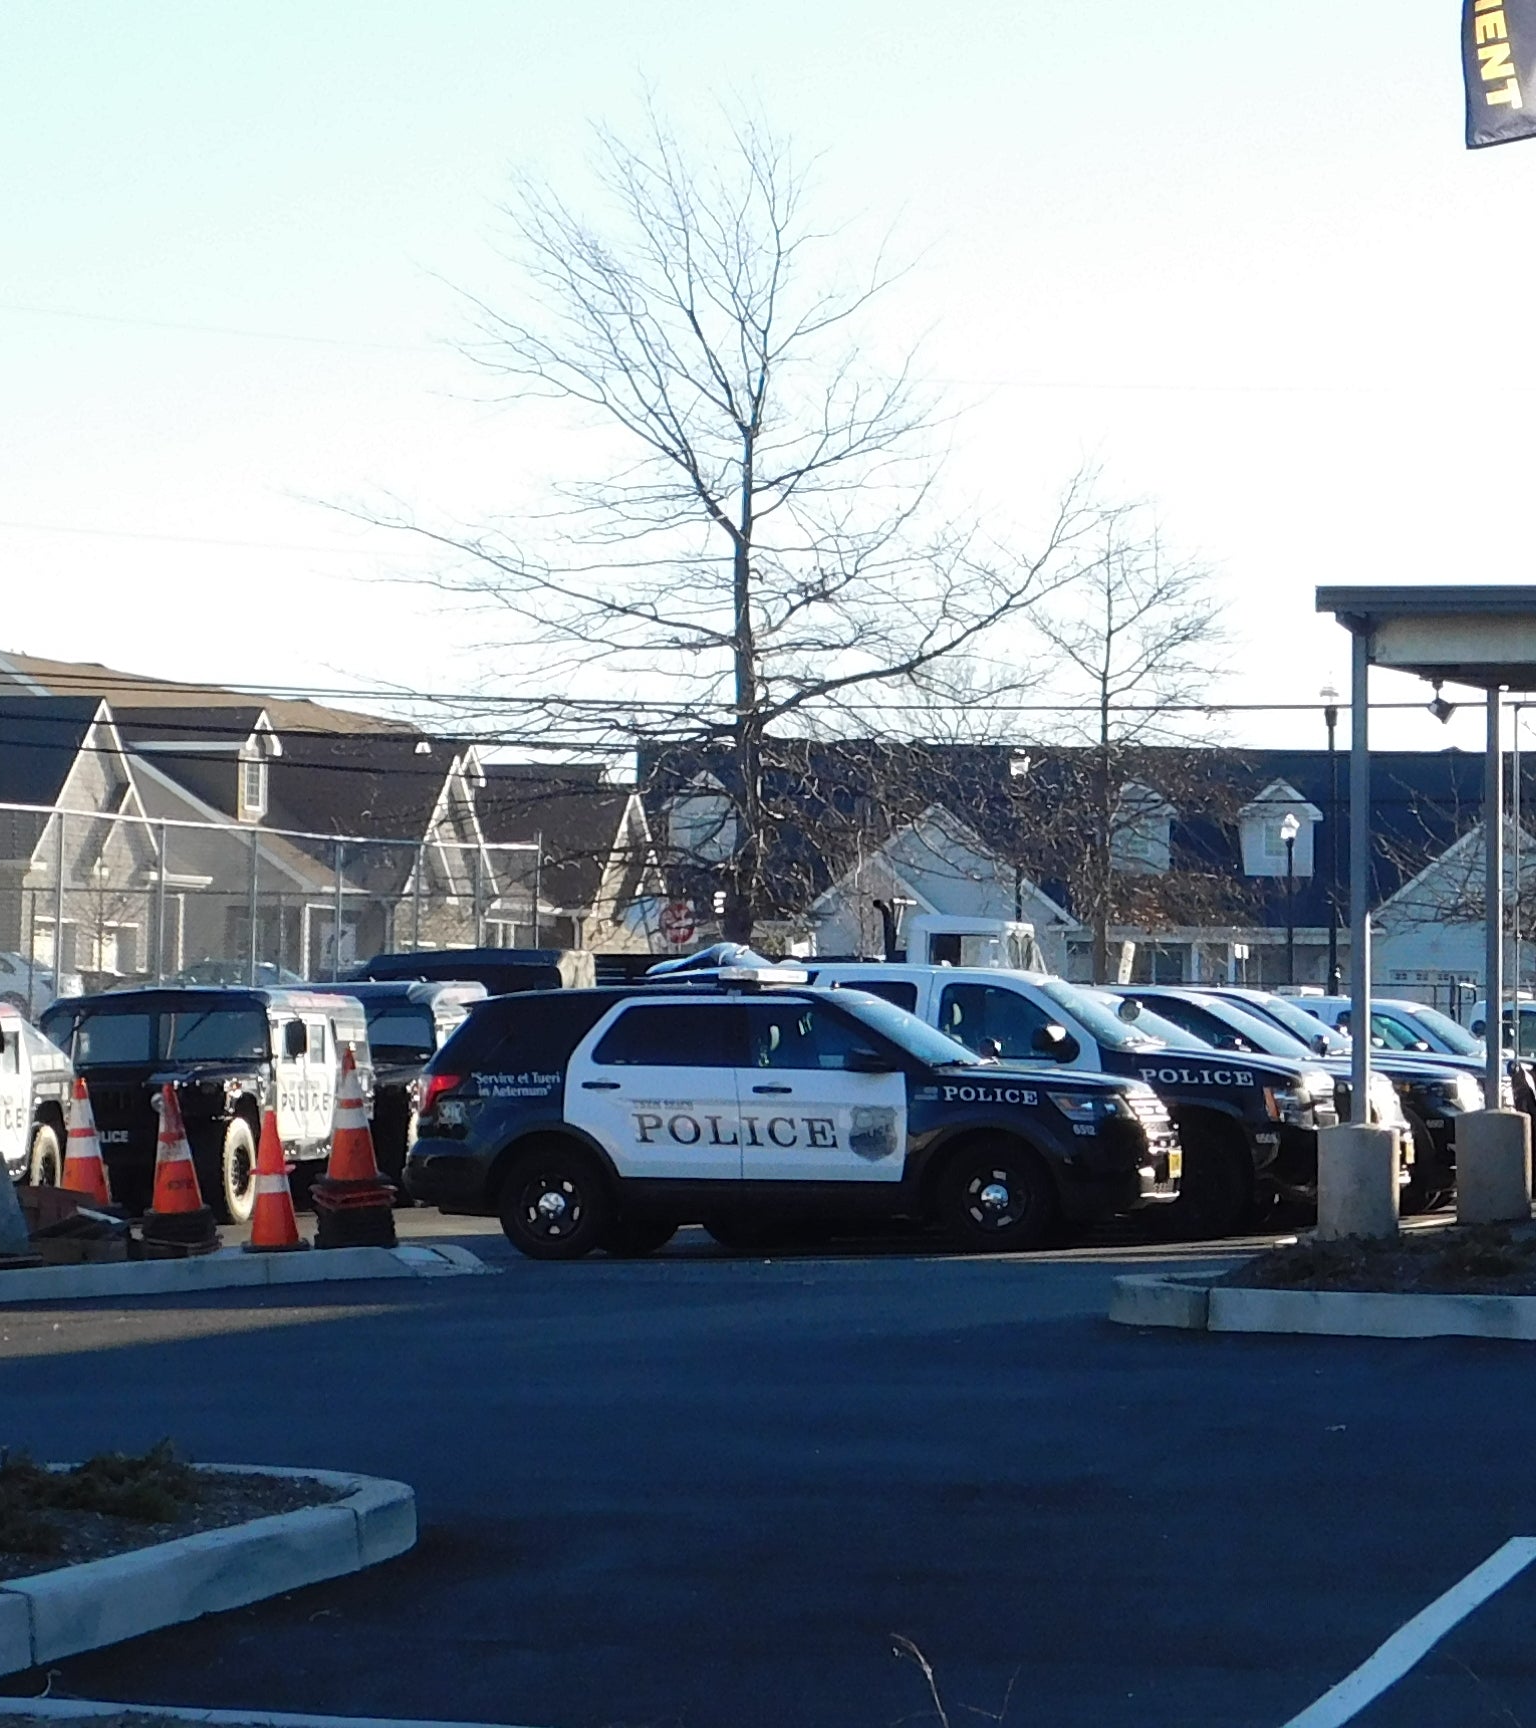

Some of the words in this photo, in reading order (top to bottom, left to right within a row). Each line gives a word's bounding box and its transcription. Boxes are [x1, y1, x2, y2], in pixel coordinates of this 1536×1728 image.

[1138, 1067, 1255, 1088] POLICE
[281, 1092, 332, 1112] POLICE
[943, 1085, 1039, 1106] POLICE
[631, 1113, 839, 1149] POLICE
